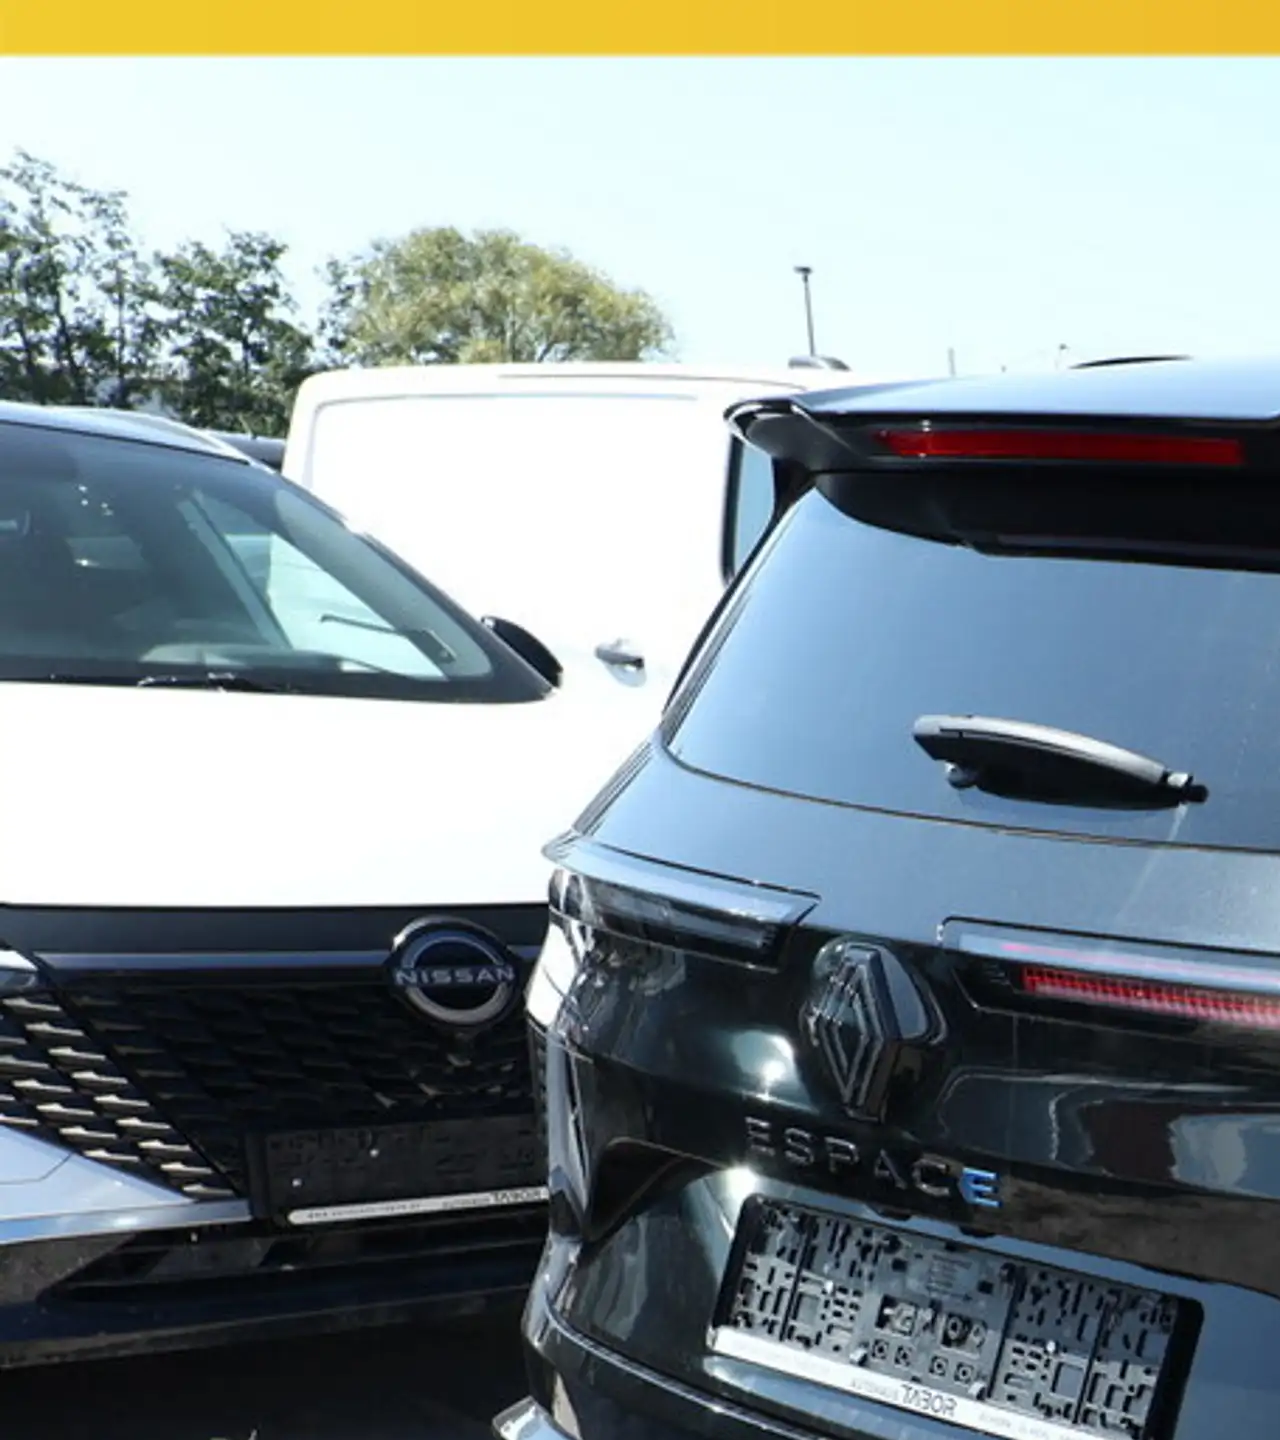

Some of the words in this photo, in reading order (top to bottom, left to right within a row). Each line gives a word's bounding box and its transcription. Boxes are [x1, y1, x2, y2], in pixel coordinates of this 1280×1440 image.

[394, 965, 514, 985] NISSAN
[745, 1116, 1000, 1206] ESPACE
[900, 1384, 957, 1417] TABOR
